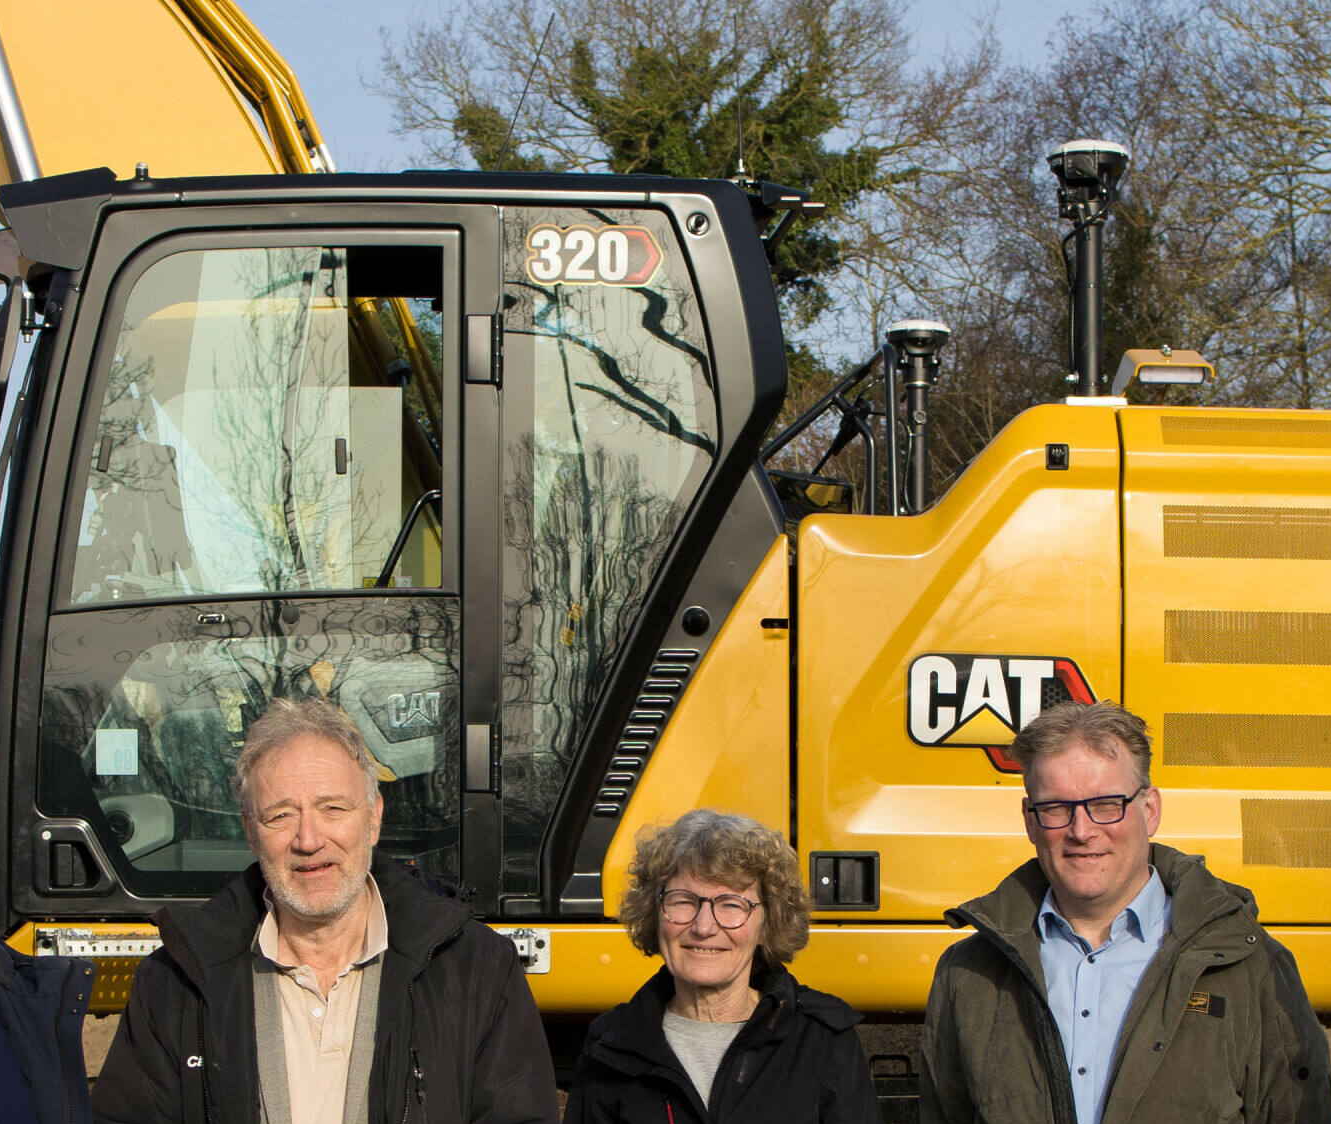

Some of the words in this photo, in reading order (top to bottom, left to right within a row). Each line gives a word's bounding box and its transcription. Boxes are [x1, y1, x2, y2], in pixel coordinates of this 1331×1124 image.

[531, 229, 629, 281] 320
[387, 691, 441, 728] CAT
[910, 655, 1054, 744] CAT
